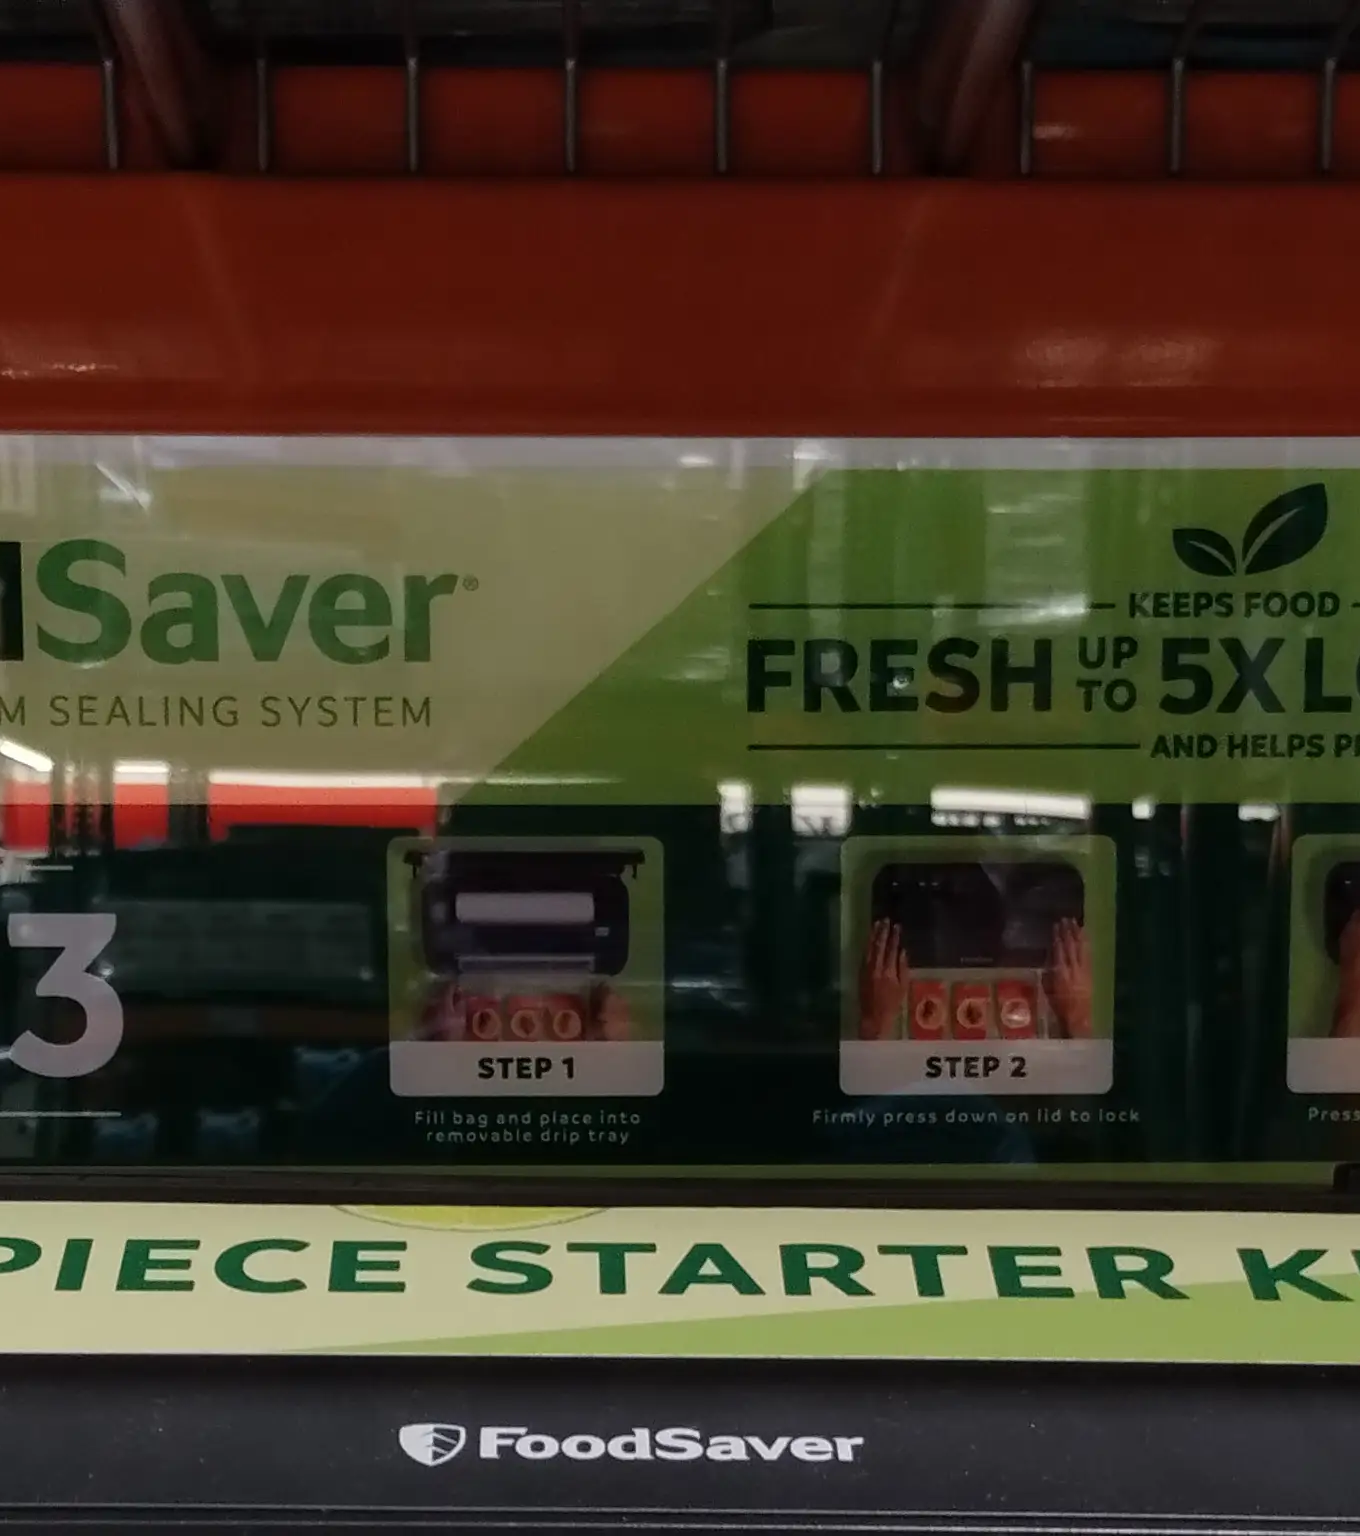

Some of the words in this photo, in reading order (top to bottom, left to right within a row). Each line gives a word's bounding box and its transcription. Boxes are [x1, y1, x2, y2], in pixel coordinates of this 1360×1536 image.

[1128, 590, 1234, 620] KEEPS
[1243, 590, 1341, 619] FOOD
[1077, 635, 1139, 671] UP
[746, 636, 1053, 714] FRESH
[1158, 636, 1287, 716] 5X
[48, 694, 240, 728] SEALING
[260, 694, 433, 728] SYSTEM
[1075, 678, 1138, 714] TO
[1149, 733, 1219, 760] AND
[1226, 733, 1326, 760] HELPS
[476, 1056, 554, 1080] STEP
[561, 1057, 576, 1080] 1
[924, 1055, 1002, 1079] STEP
[1009, 1055, 1029, 1079] 2
[414, 1110, 446, 1125] Fill
[452, 1111, 489, 1128] bag
[496, 1110, 533, 1125] and
[539, 1110, 593, 1129] place
[599, 1110, 641, 1125] into
[812, 1108, 877, 1128] Firmly
[882, 1112, 938, 1128] press
[945, 1108, 999, 1124] down
[1005, 1112, 1030, 1124] on
[1036, 1108, 1062, 1123] lid
[1069, 1109, 1090, 1123] to
[1098, 1107, 1141, 1123] lock
[426, 1129, 533, 1143] removable
[540, 1128, 581, 1145] drip
[587, 1129, 631, 1145] tray
[465, 1240, 1191, 1301] STARTER
[477, 1425, 866, 1464] FoodSaver
